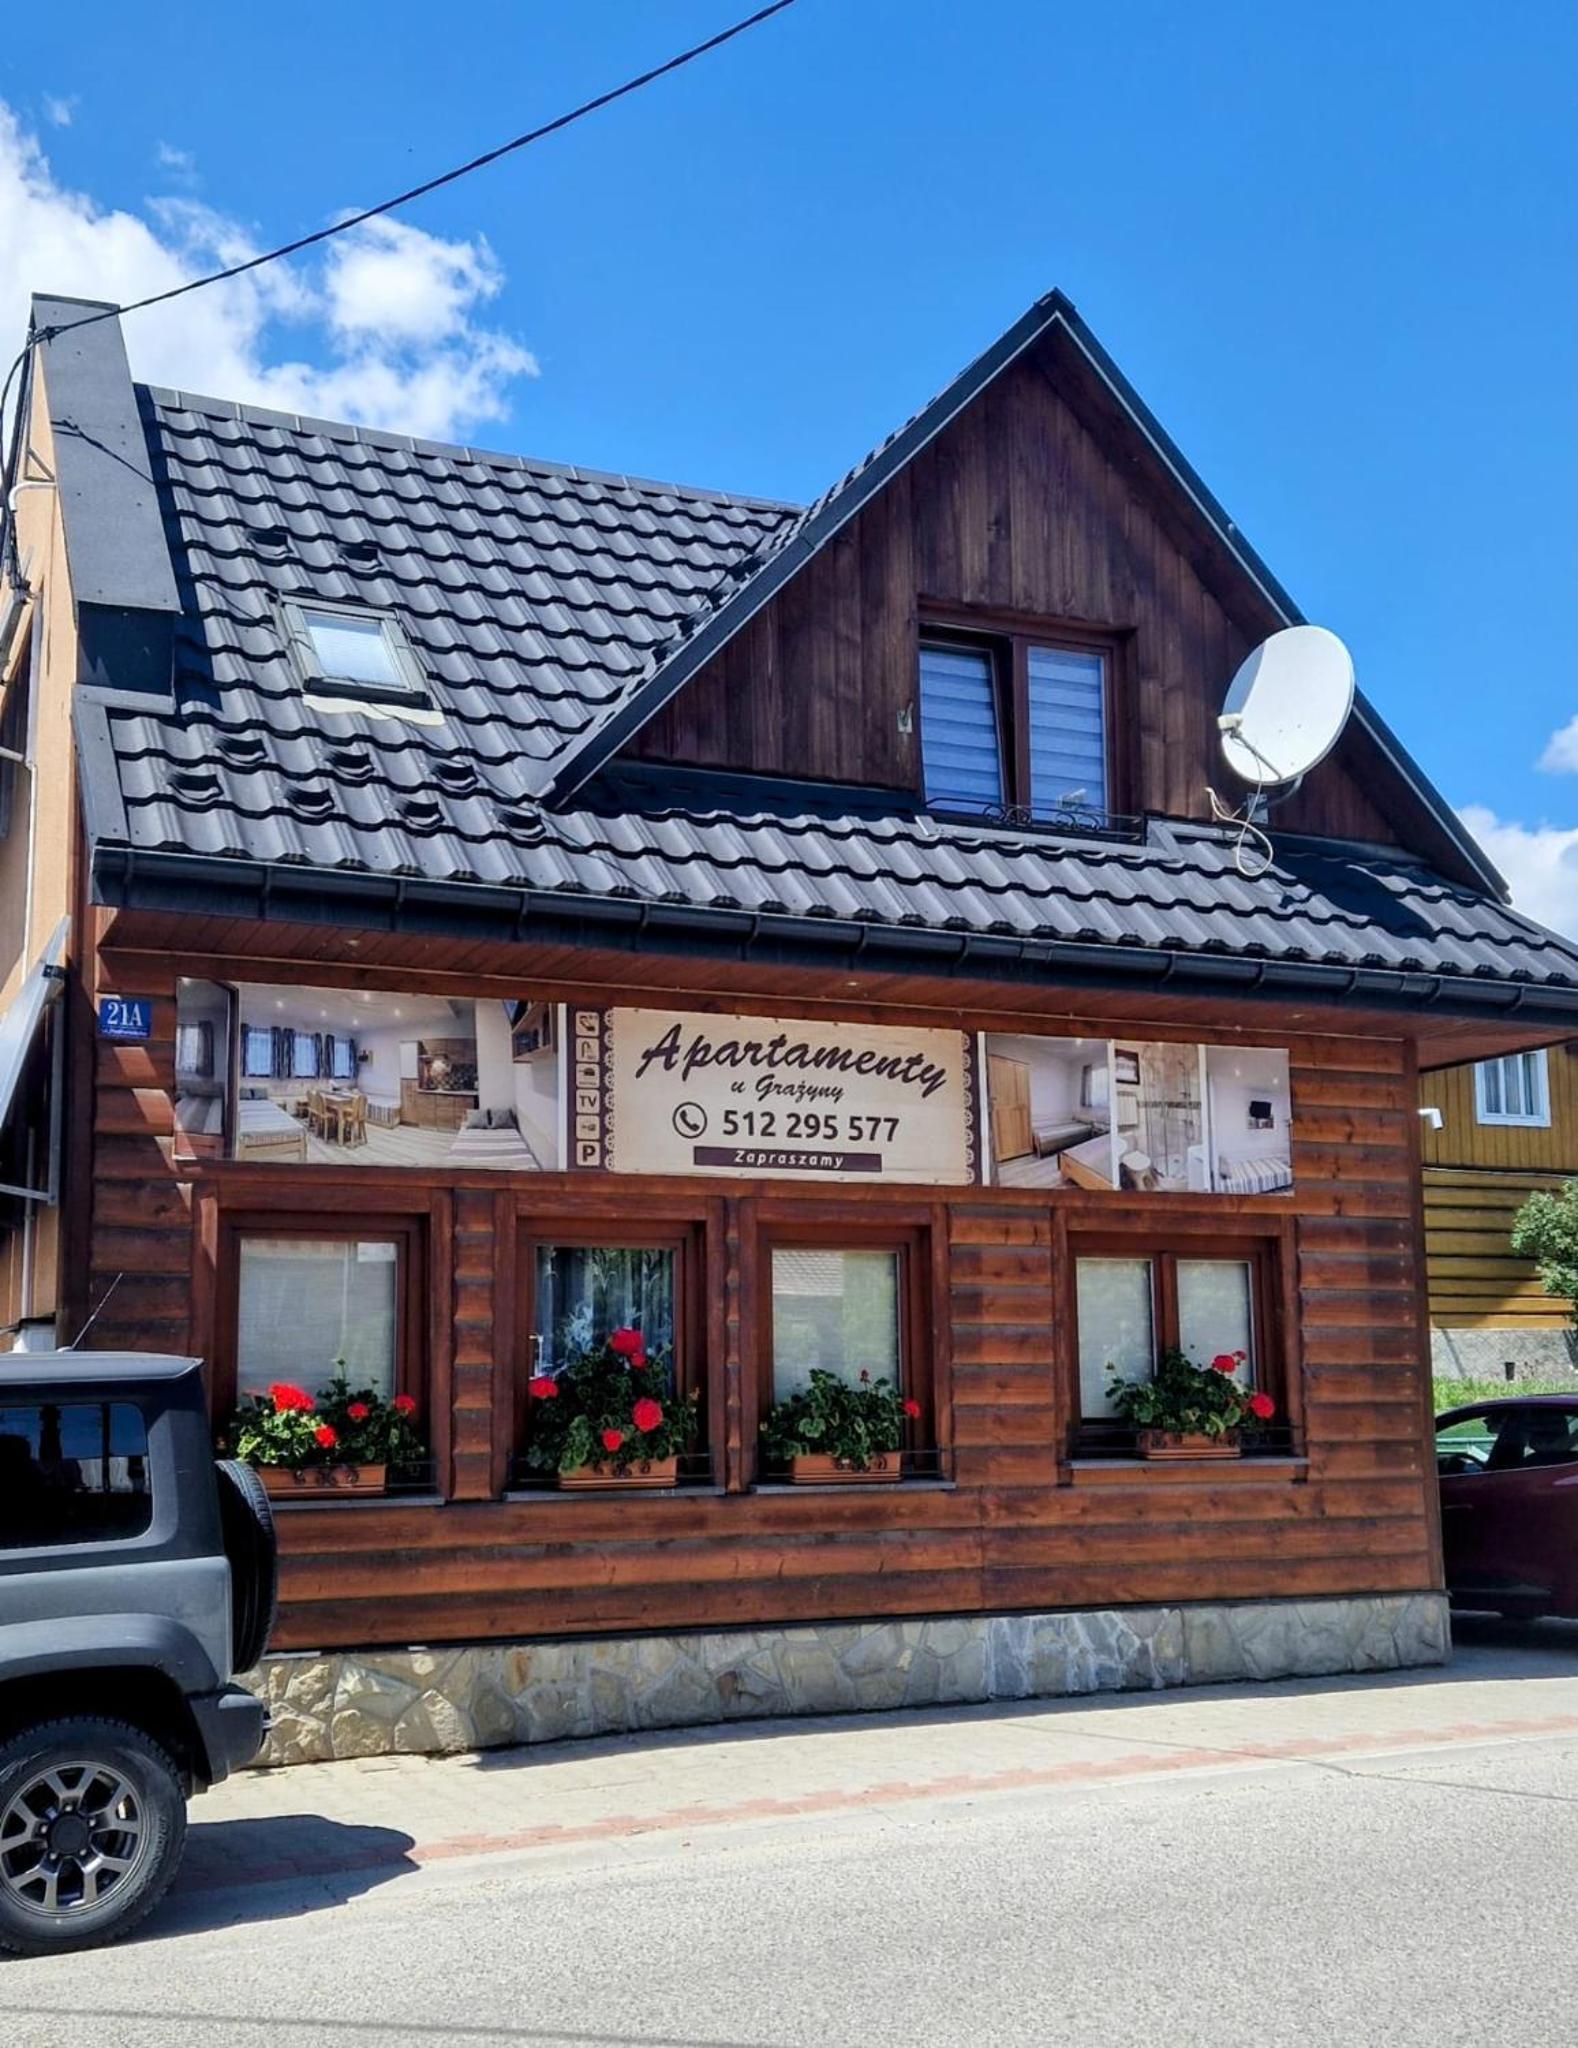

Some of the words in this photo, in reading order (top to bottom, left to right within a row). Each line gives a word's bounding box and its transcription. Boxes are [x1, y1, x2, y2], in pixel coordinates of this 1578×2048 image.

[107, 1002, 143, 1026] 21A
[635, 1023, 948, 1098] Apartamenty
[731, 1080, 744, 1094] u
[755, 1073, 846, 1103] Grażyny
[579, 1095, 597, 1108] TV
[722, 1110, 777, 1137] 512
[785, 1112, 839, 1140] 295
[848, 1116, 900, 1142] 577
[582, 1144, 596, 1162] P
[733, 1150, 845, 1169] Zapraszamy
